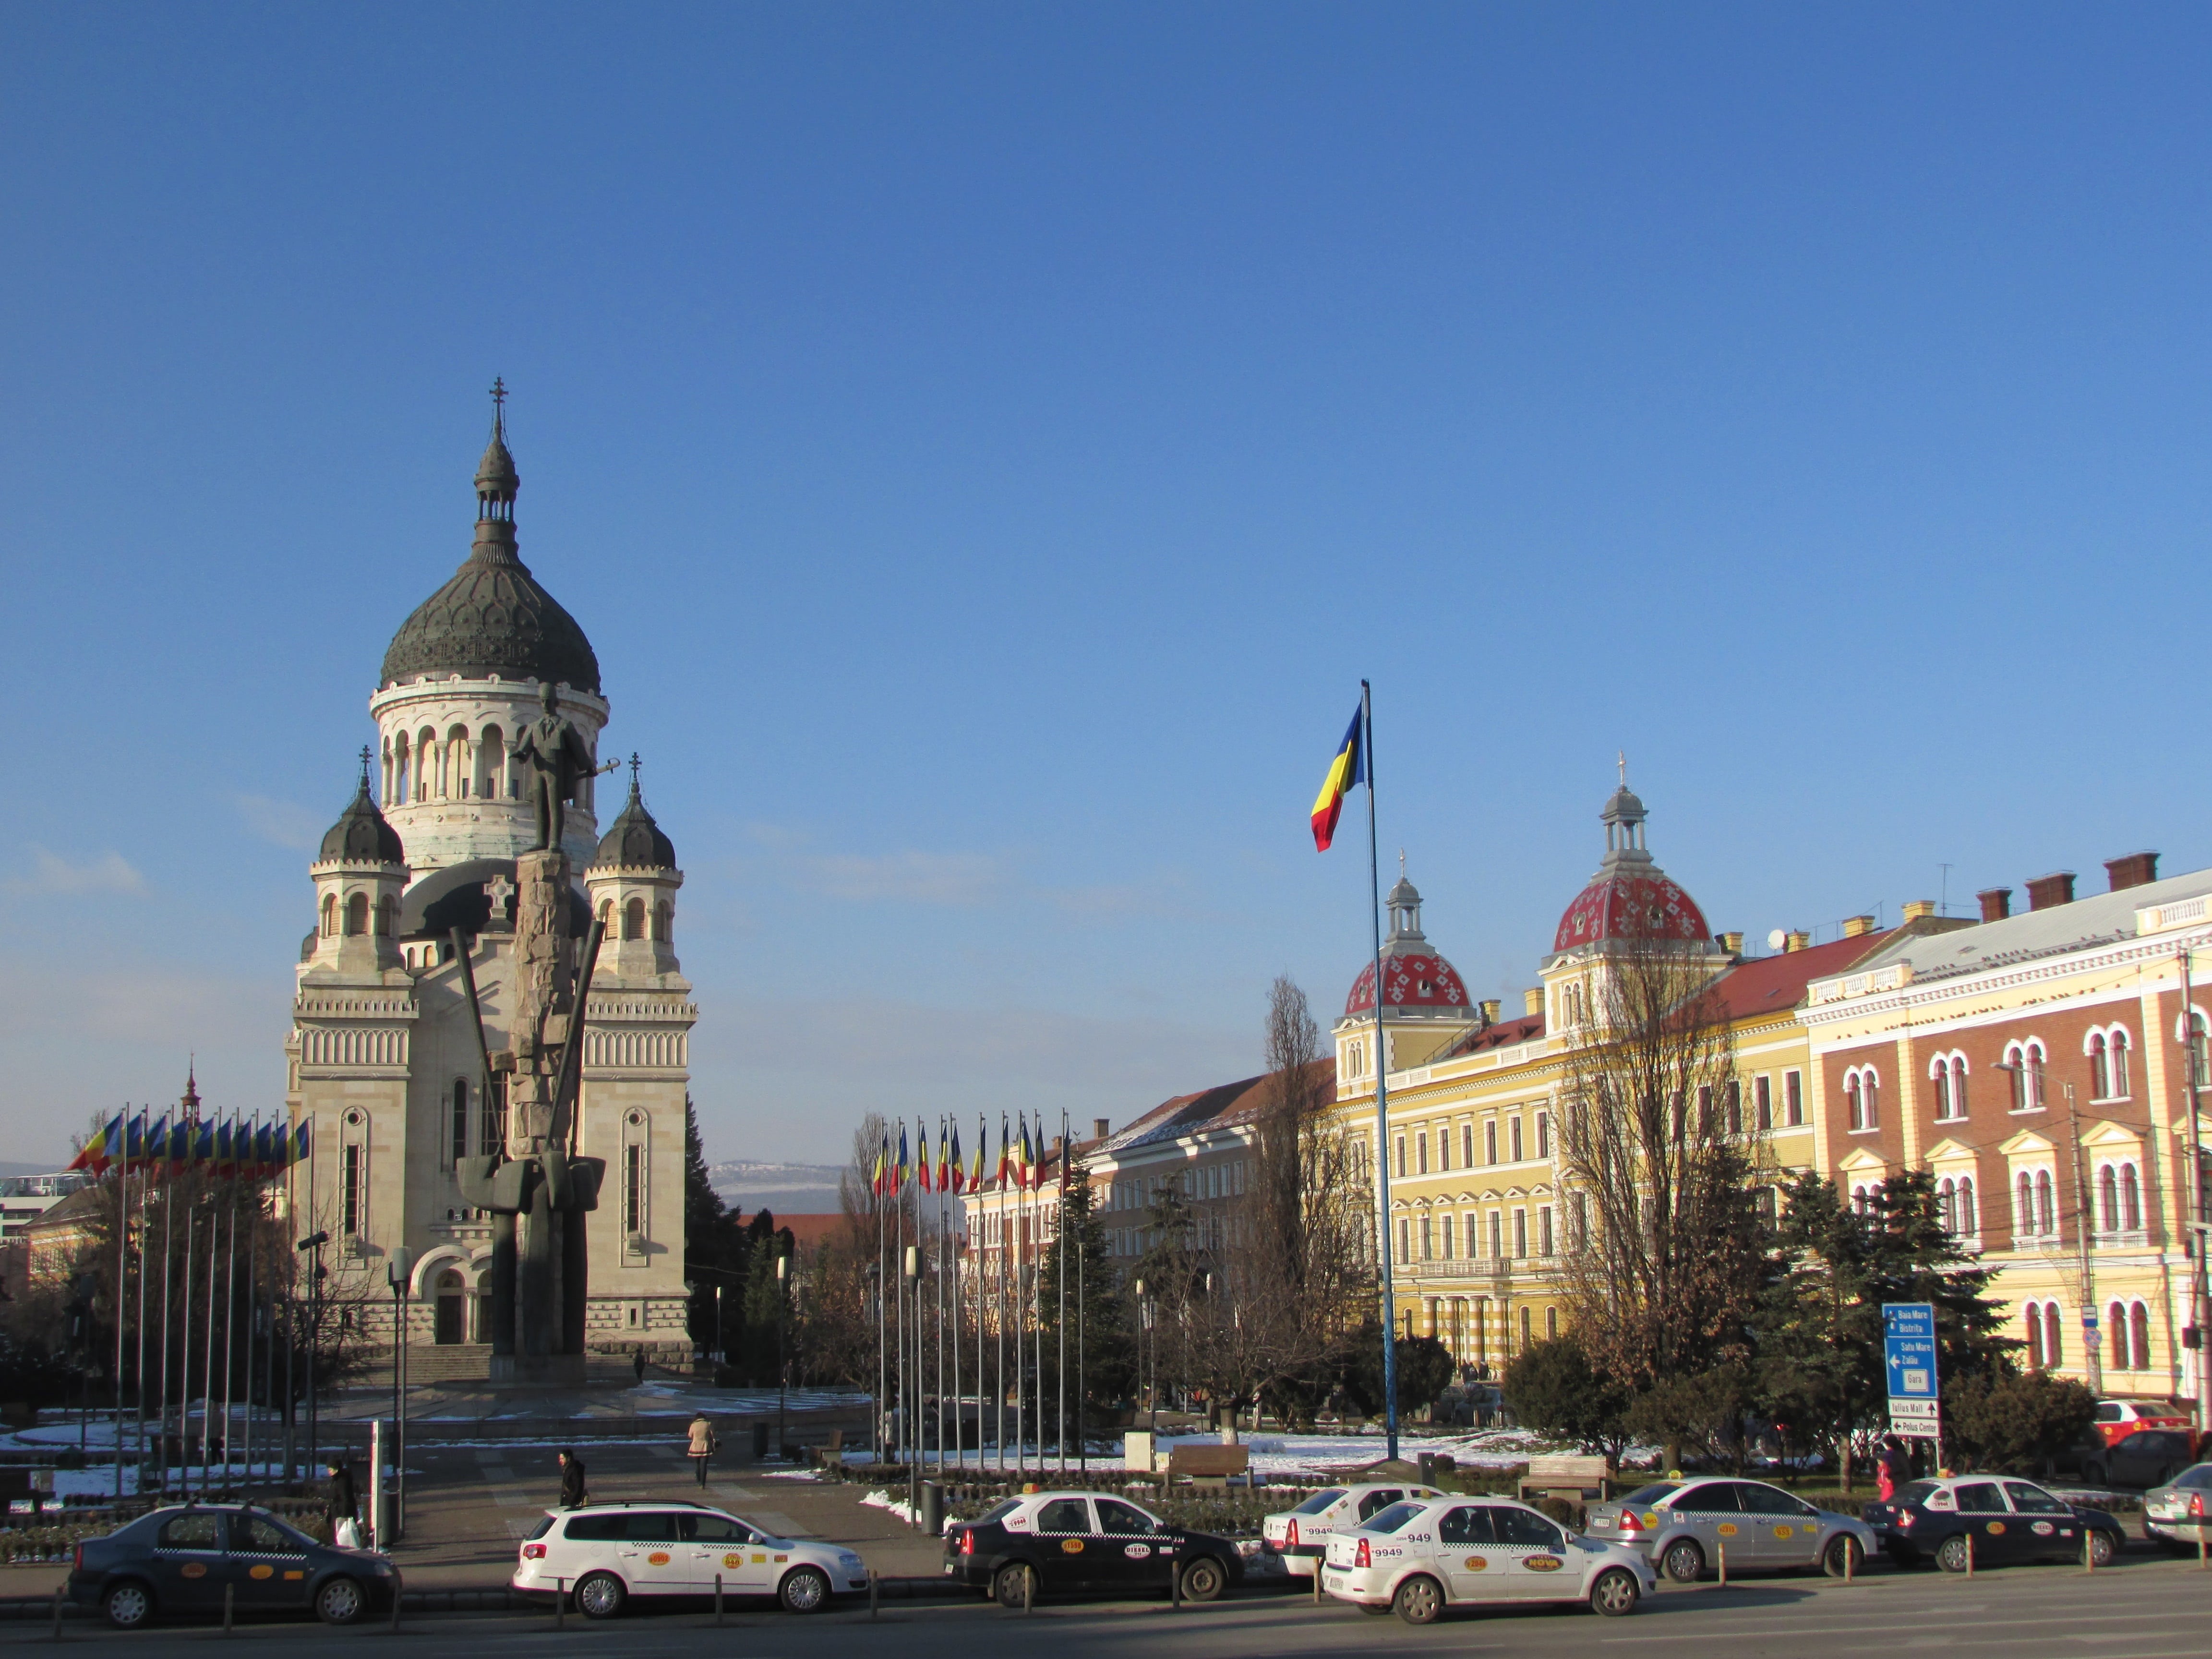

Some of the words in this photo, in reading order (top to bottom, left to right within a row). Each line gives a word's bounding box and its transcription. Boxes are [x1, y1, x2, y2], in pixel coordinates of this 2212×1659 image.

[1898, 1310, 1911, 1319] Baia
[1912, 1310, 1928, 1319] Mare
[1901, 1342, 1914, 1351] Satu
[1915, 1342, 1931, 1352] Mare
[1908, 1374, 1922, 1383] Gara
[1892, 1403, 1909, 1412] Iulius
[1911, 1404, 1923, 1413] Mall
[1903, 1422, 1918, 1431] Polus
[1919, 1422, 1936, 1432] Center
[1529, 1559, 1559, 1567] NOVA
